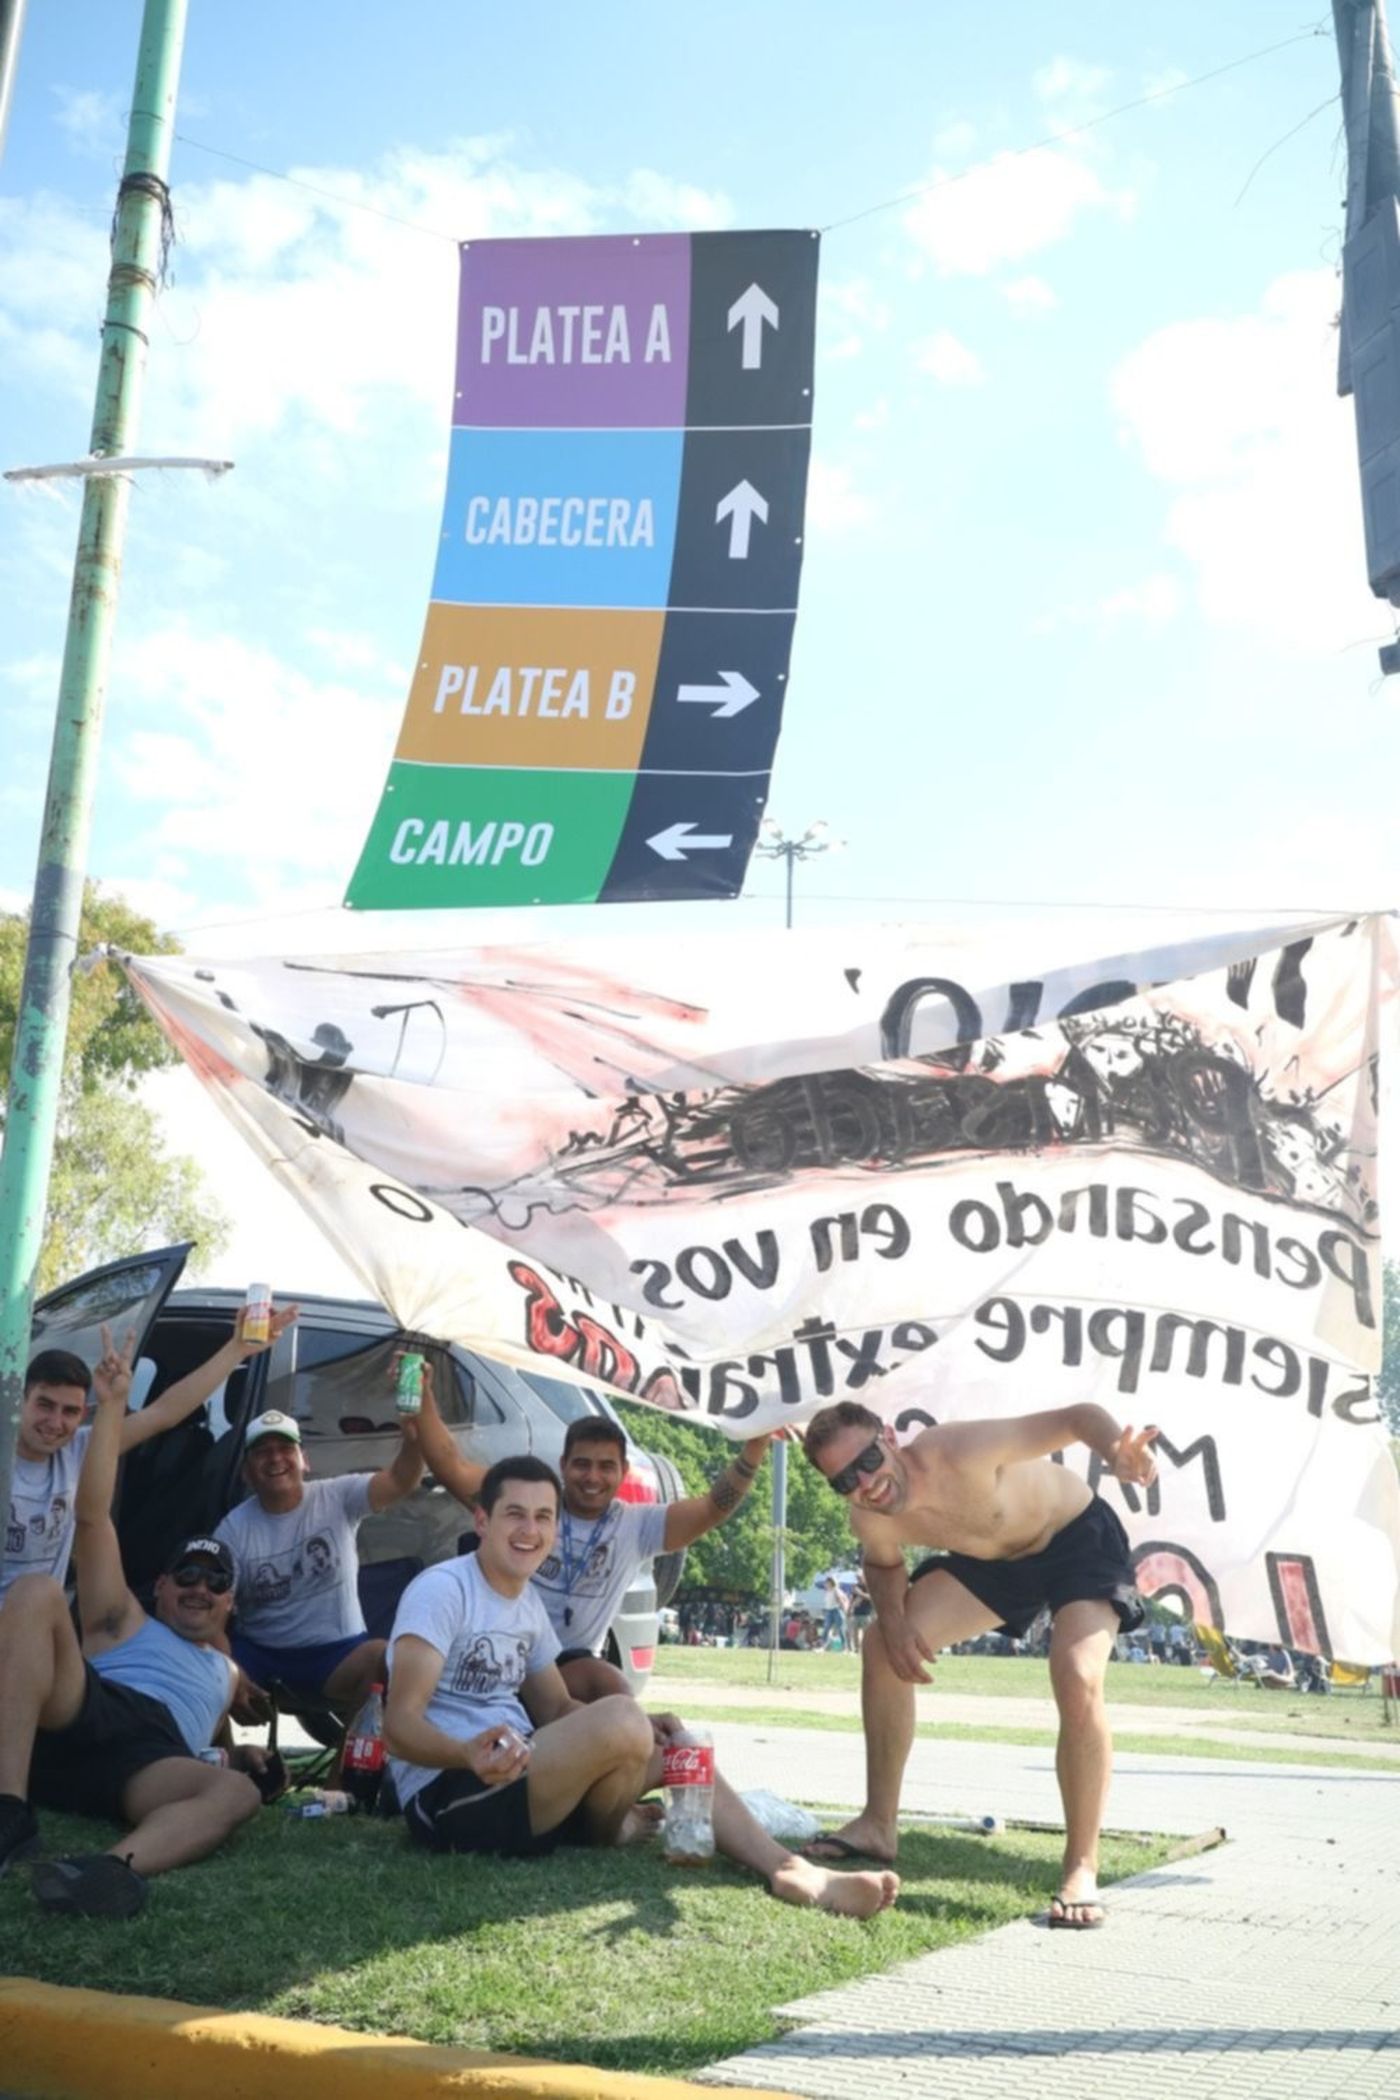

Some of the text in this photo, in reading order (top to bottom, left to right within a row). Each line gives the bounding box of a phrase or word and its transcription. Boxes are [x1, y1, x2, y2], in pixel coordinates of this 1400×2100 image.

[480, 304, 672, 364] PLATEA A
[464, 496, 655, 548] CABECERA
[433, 665, 636, 721] PLATEA B
[388, 817, 554, 866] CAMPO
